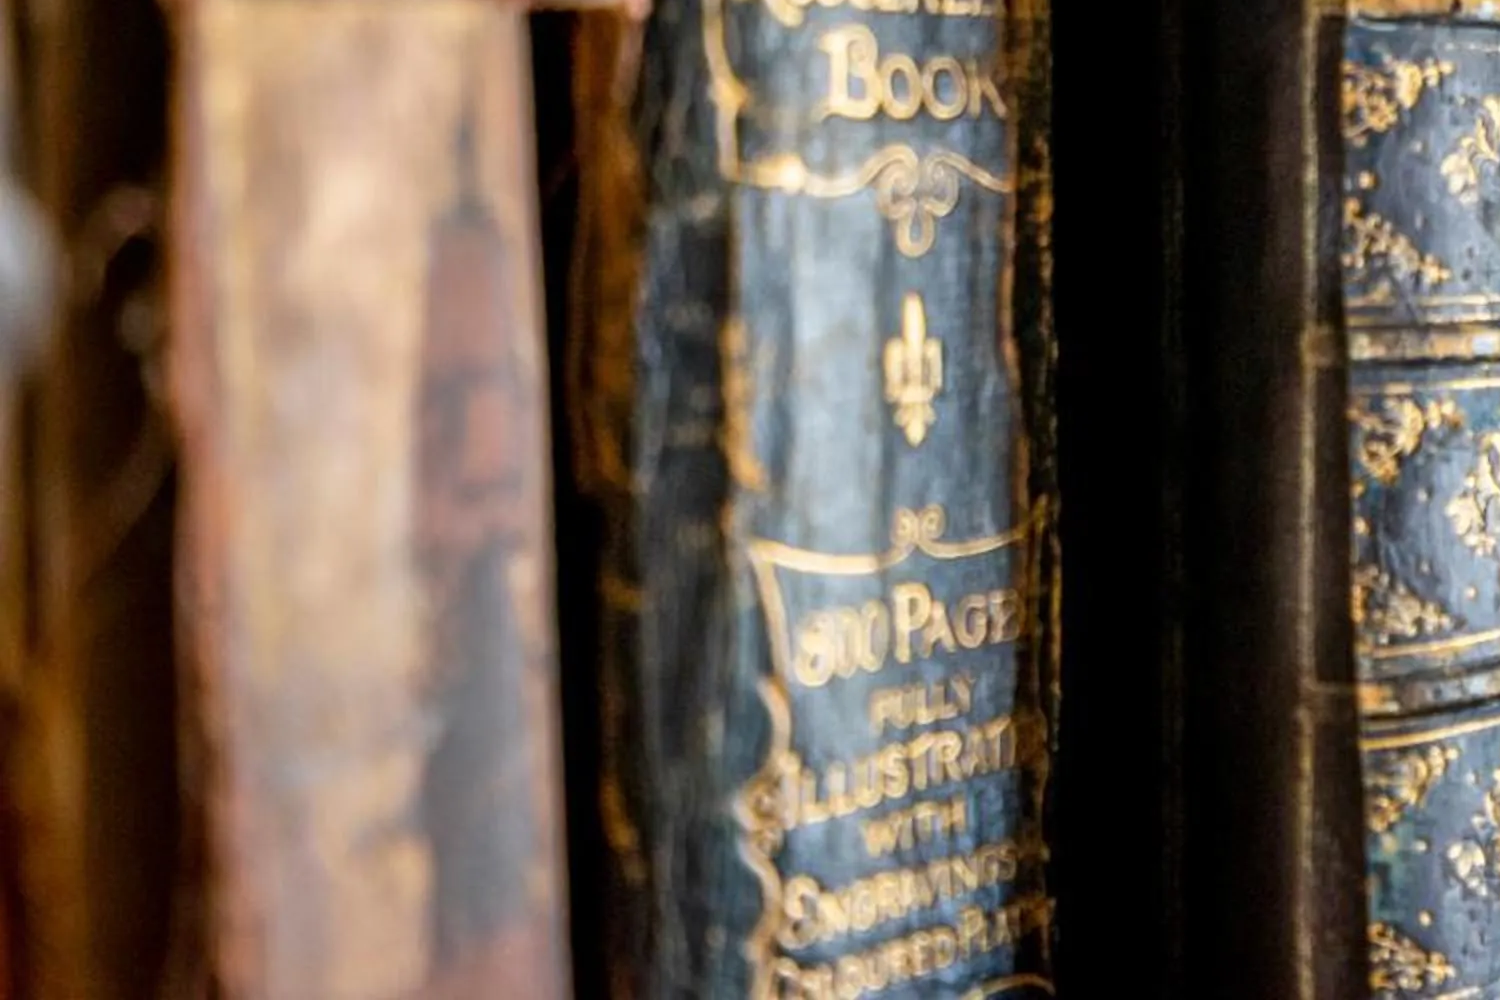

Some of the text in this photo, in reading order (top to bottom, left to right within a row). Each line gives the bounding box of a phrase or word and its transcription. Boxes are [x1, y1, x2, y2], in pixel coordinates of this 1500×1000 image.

[868, 673, 977, 737] FULLY
[777, 712, 1018, 832] ILLUSTRAT
[860, 796, 967, 858] WITH
